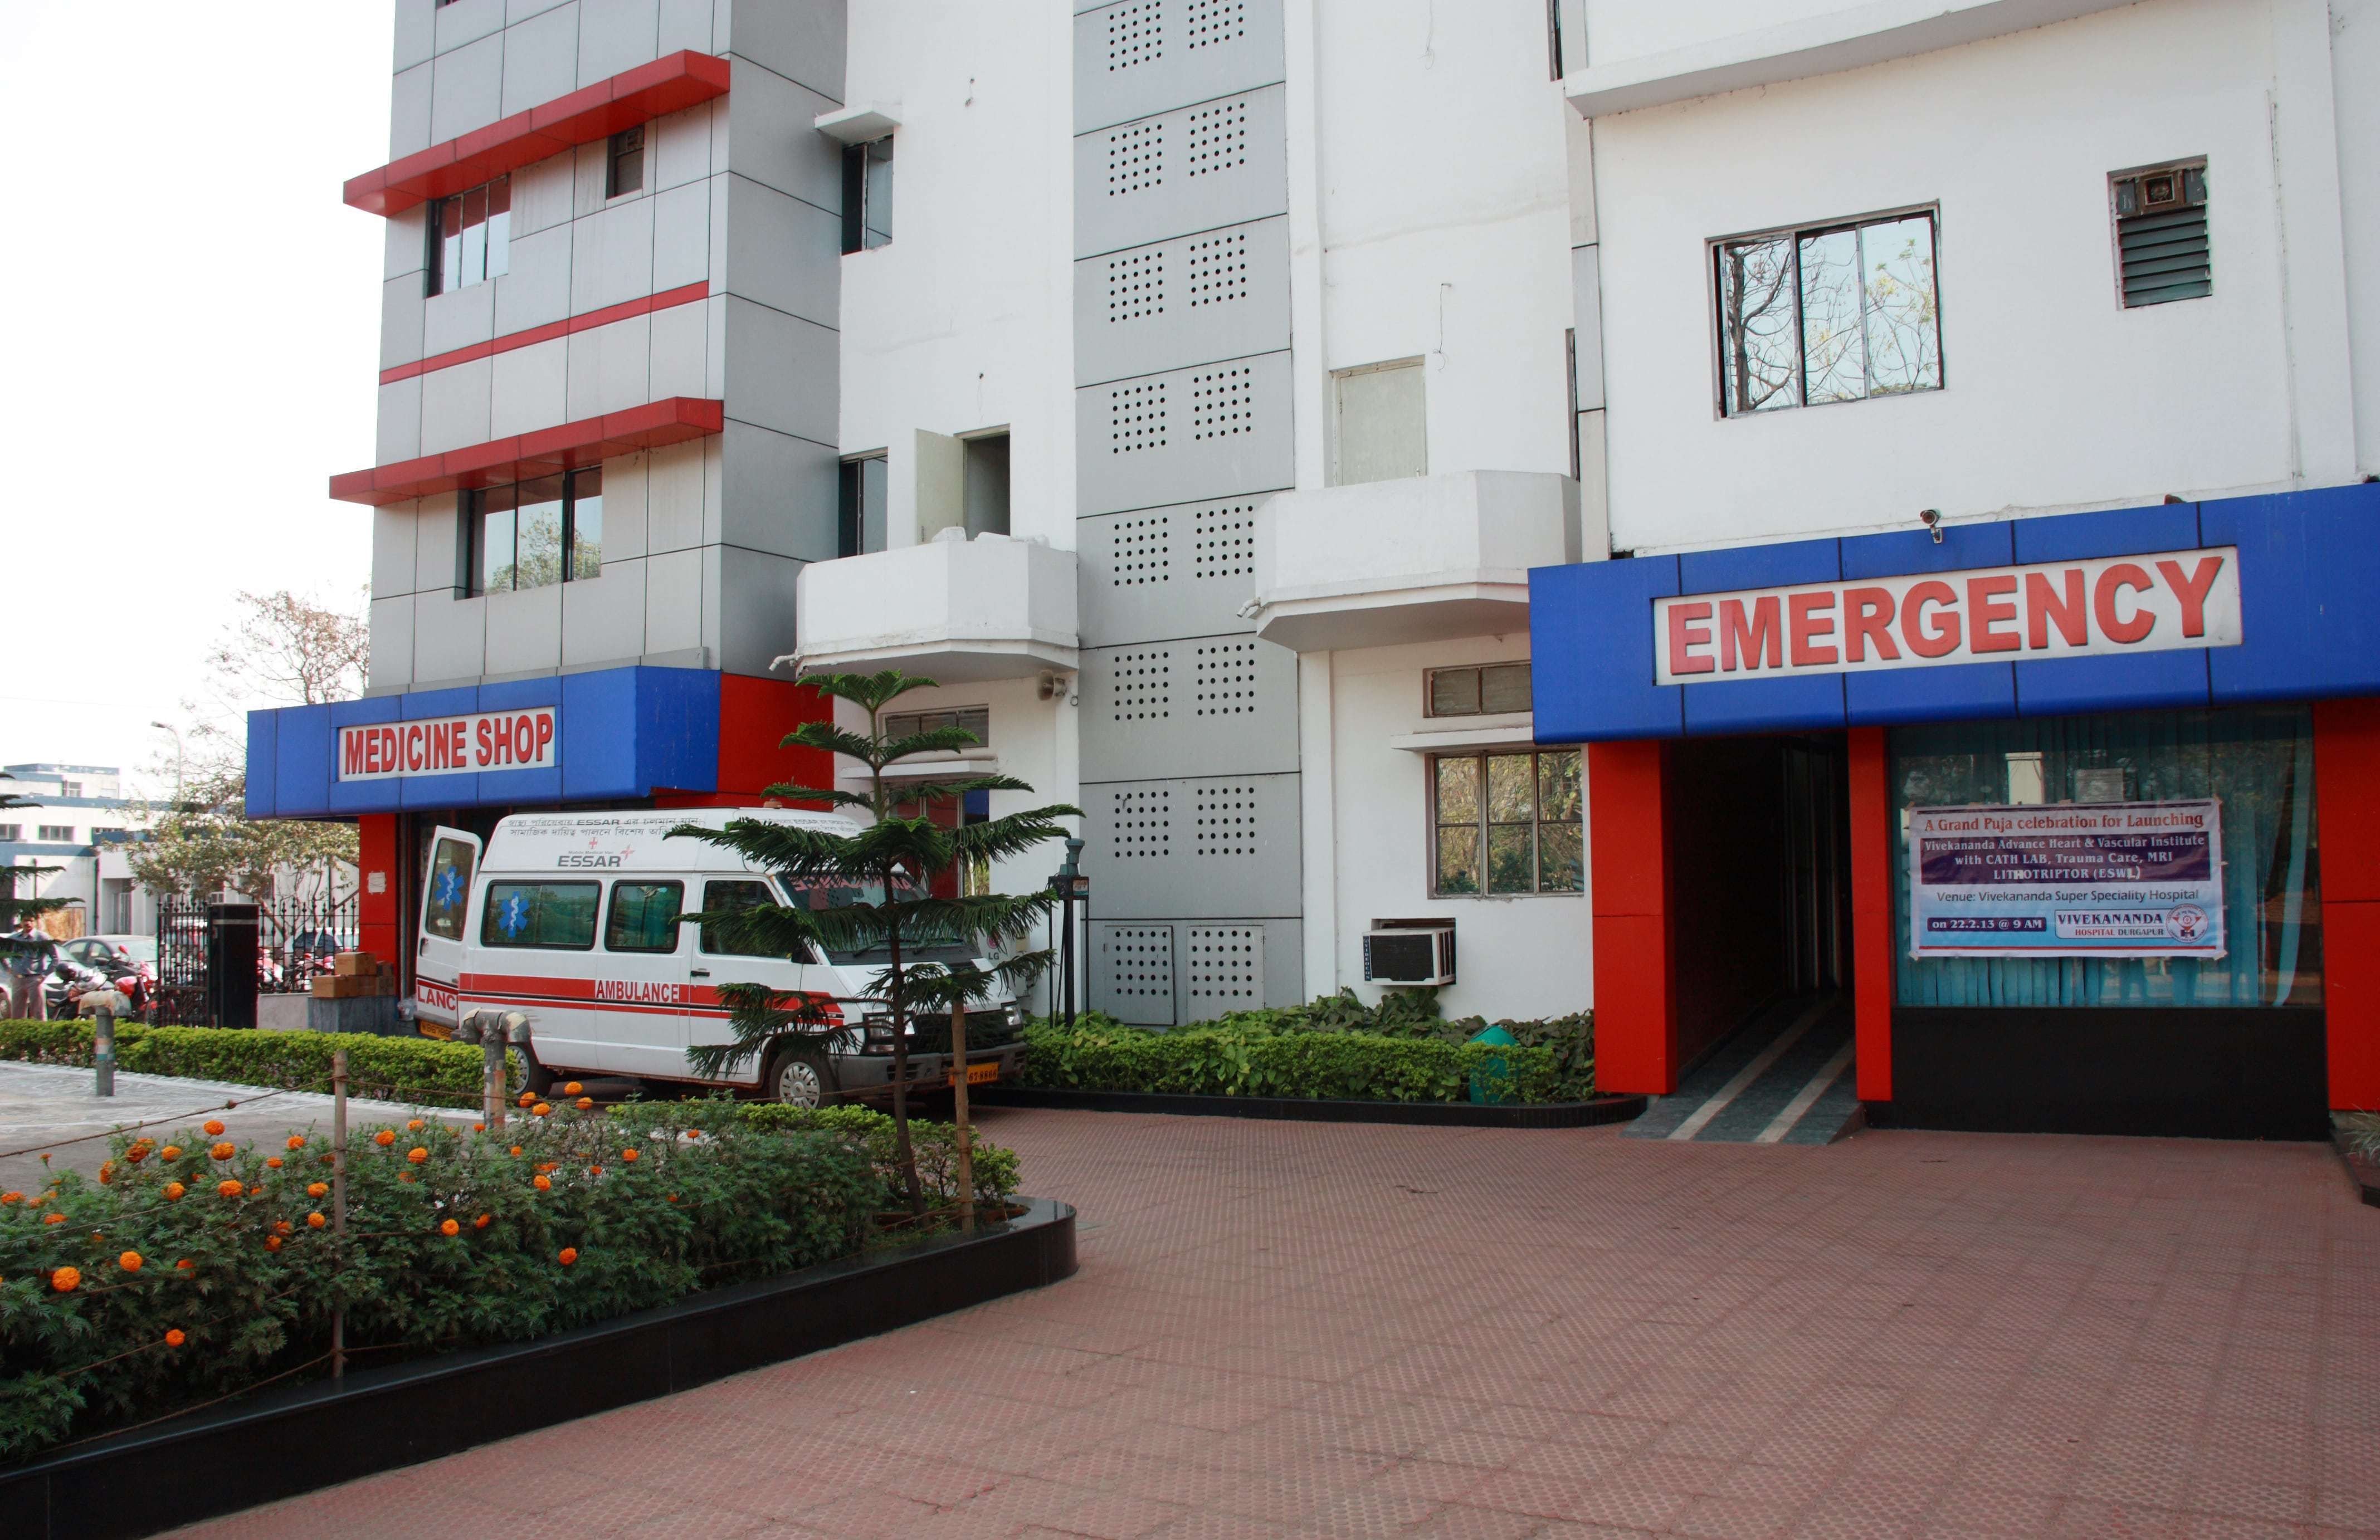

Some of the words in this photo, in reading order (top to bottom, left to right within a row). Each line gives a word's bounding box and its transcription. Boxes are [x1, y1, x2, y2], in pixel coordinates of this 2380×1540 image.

[1667, 555, 2224, 675] EMERGENCY
[345, 721, 466, 775] MEDICINE
[476, 713, 553, 766] SHOP
[1925, 820, 1934, 831] A
[1938, 818, 1979, 830] Grand
[1984, 818, 2012, 833] Puja
[2017, 815, 2097, 829] celebration
[2103, 815, 2122, 827] for
[2127, 813, 2204, 828] Launching
[1925, 840, 1994, 850] Vivekananda
[1998, 839, 2045, 849] Advance
[2049, 838, 2081, 849] Heart
[2084, 838, 2095, 848] &
[2098, 837, 2147, 848] Vascular
[2151, 836, 2205, 847] Institute
[558, 855, 621, 867] ESSAR
[1955, 855, 1982, 865] with
[1986, 854, 2018, 864] CATH
[2023, 854, 2051, 864] LAB,
[2055, 853, 2104, 863] Trauma
[2108, 853, 2143, 863] Care,
[2148, 852, 2173, 862] MRI
[1994, 868, 2089, 880] LITHOTRIPTOR
[2094, 866, 2140, 879] (ESWL)
[1937, 892, 1976, 901] Venue:
[1979, 891, 2052, 901] Vivekananda
[2055, 891, 2088, 903] Super
[2091, 890, 2145, 903] Speciality
[2149, 889, 2198, 902] Hospital
[1932, 920, 1947, 928] on
[1950, 920, 1994, 928] 22.2.13
[1998, 920, 2010, 930] @
[2013, 920, 2021, 928] 9
[2024, 920, 2042, 928] AM
[2057, 913, 2163, 925] VIVEKANANDA
[418, 986, 456, 1011] LANC
[596, 980, 679, 1003] AMBULANCE
